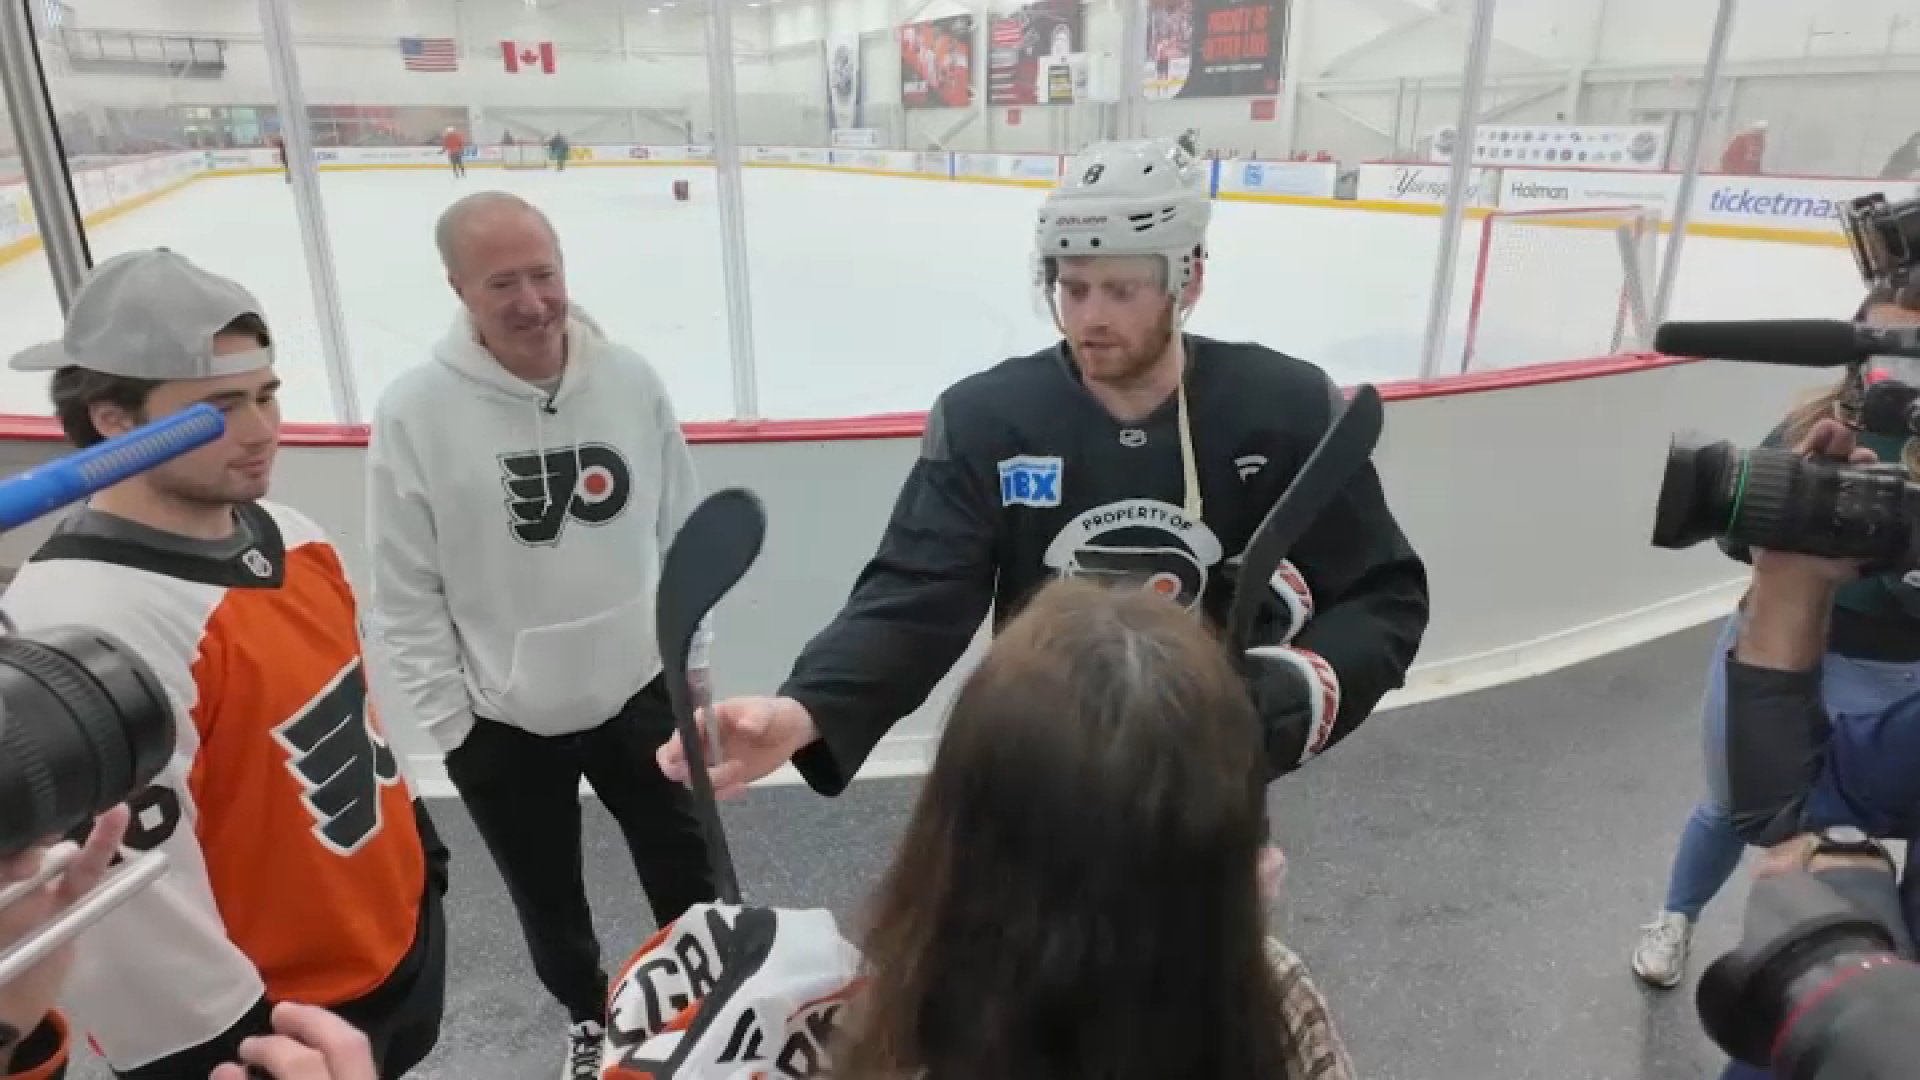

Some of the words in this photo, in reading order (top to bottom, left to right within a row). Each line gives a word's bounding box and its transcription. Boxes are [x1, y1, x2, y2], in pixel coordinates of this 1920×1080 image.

[1083, 164, 1104, 184] 8
[1511, 181, 1569, 200] Holman
[1710, 185, 1844, 219] ticketmas
[1002, 470, 1058, 502] IBX
[1082, 505, 1169, 531] PROPERTY
